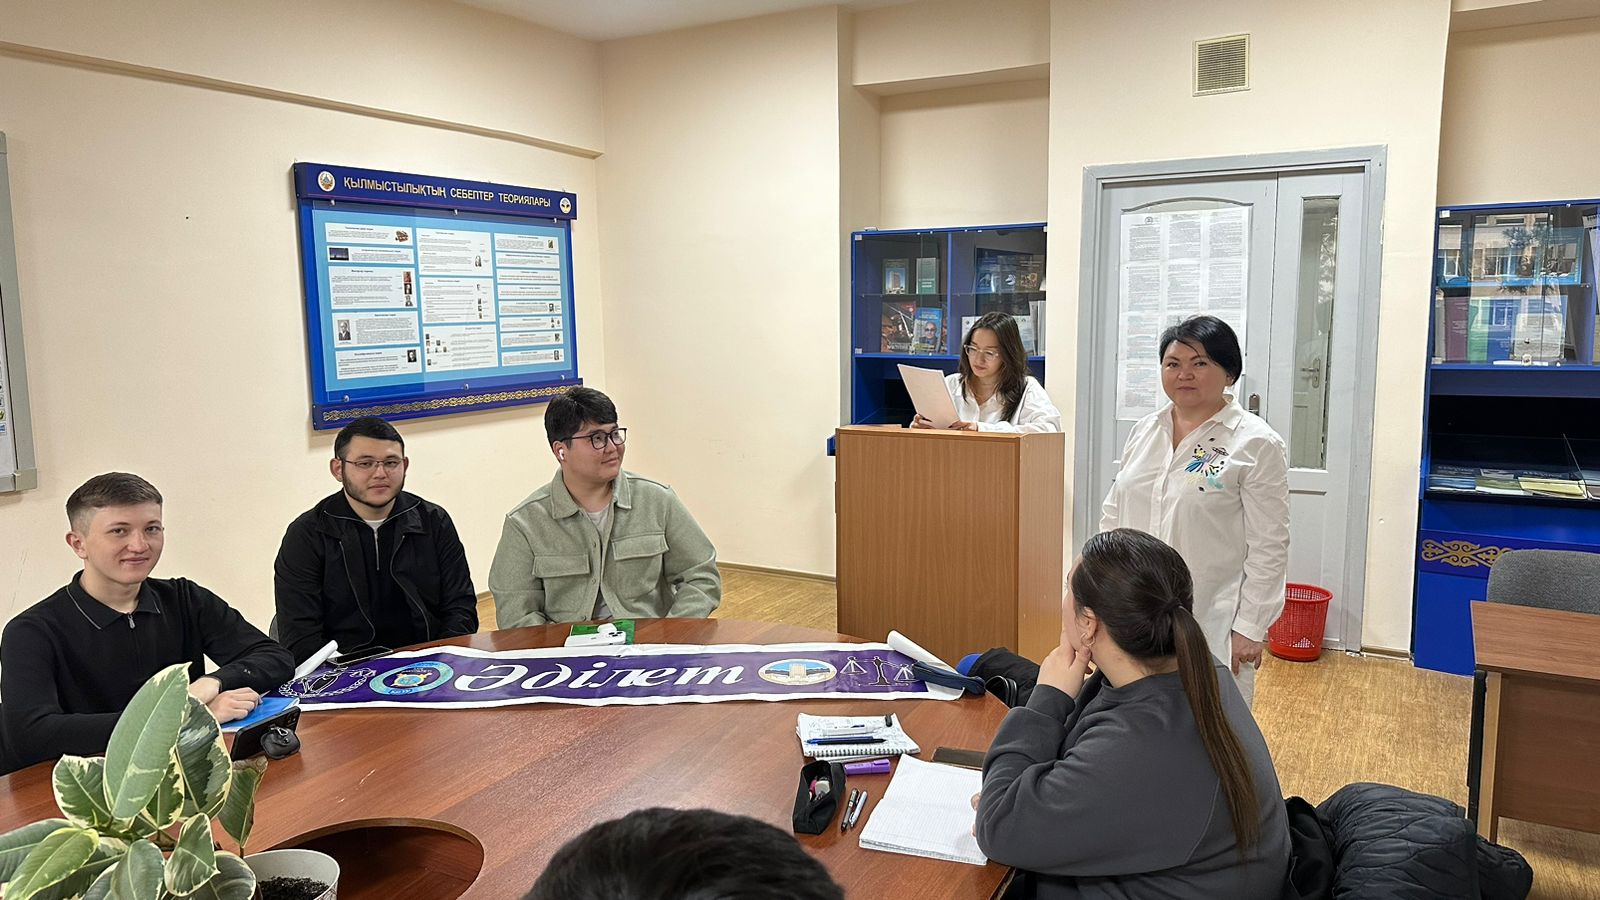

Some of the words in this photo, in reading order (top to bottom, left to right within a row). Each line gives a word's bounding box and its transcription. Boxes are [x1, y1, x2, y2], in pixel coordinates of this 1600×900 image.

[343, 177, 447, 198] ҚЫЛМЫСТЫЛЫҚТЫҢ
[450, 188, 494, 201] СЕБЕПТЕР
[498, 193, 551, 207] ТЕОРИЯЛАРЫ
[454, 661, 745, 692] Әділет
